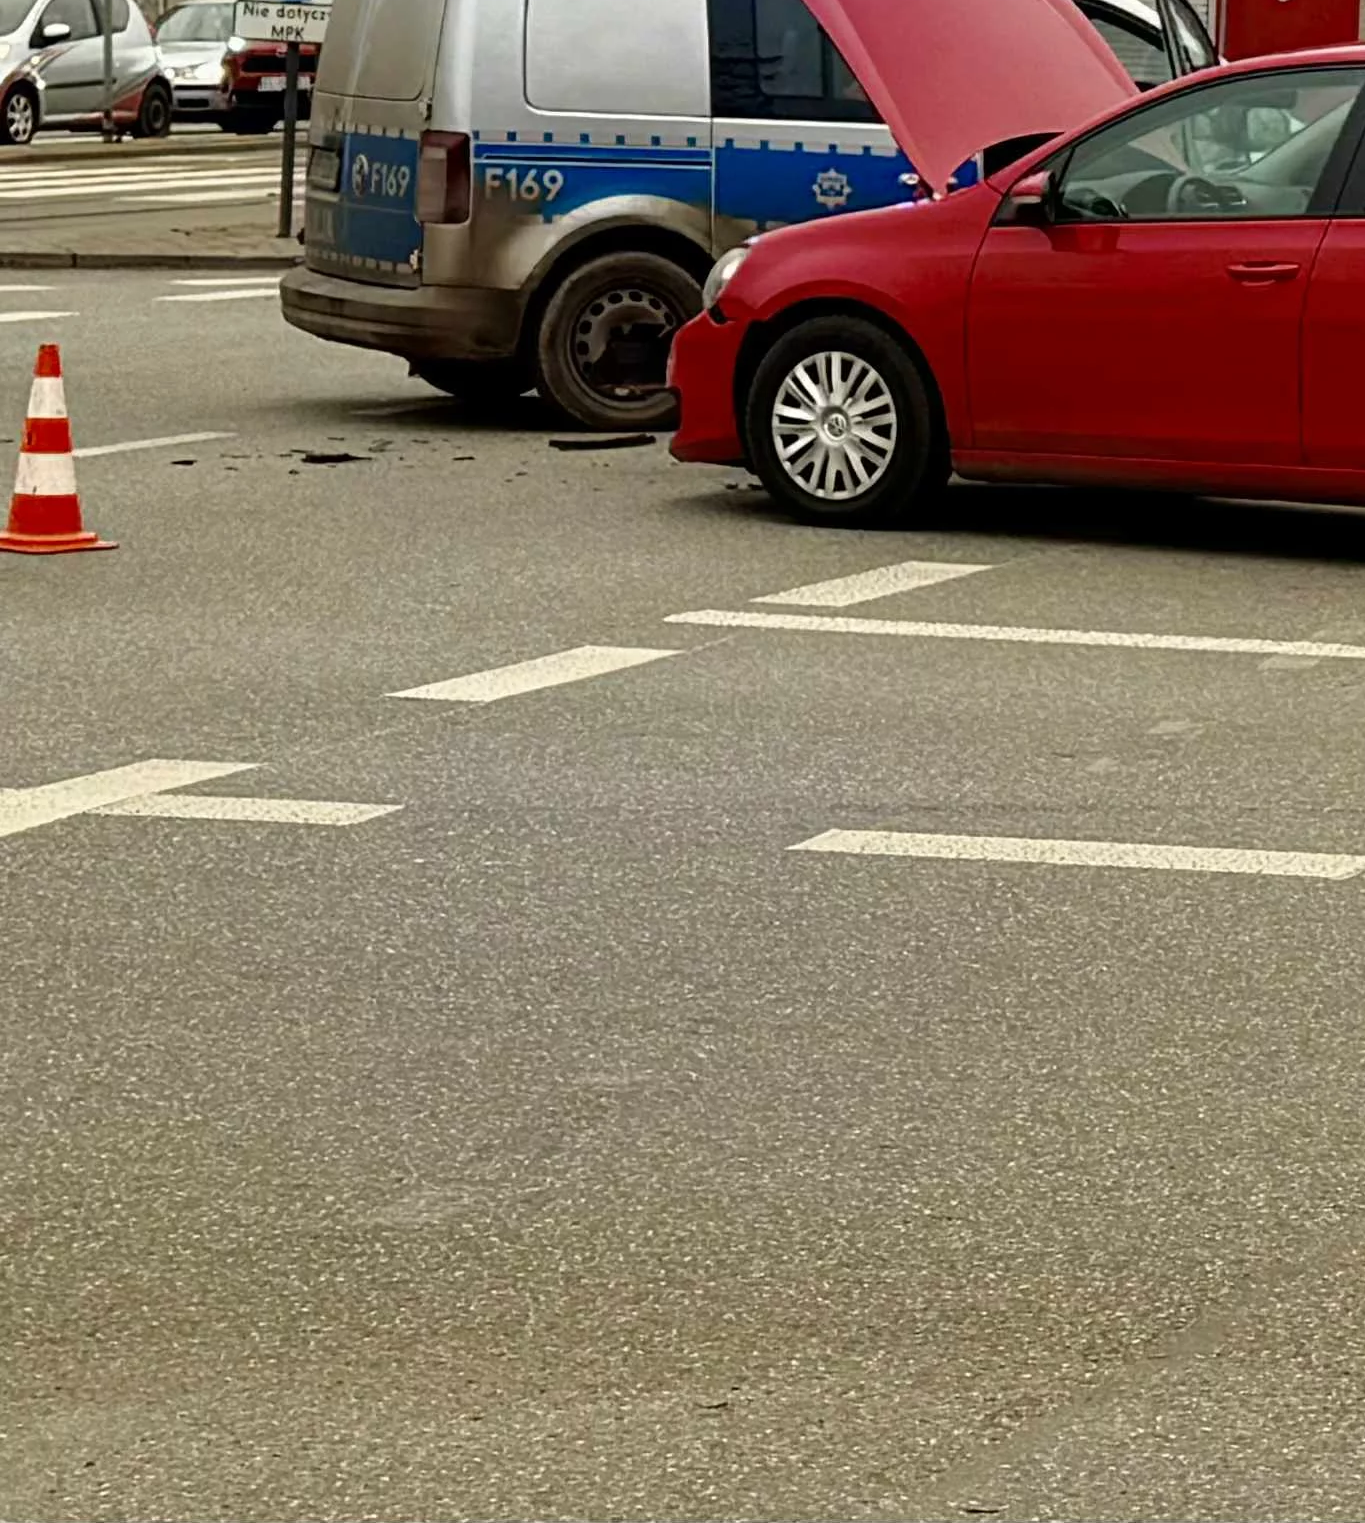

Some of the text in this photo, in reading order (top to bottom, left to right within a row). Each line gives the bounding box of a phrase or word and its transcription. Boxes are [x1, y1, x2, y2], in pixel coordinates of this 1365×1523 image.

[242, 2, 269, 17] Nie
[271, 25, 305, 41] MPK
[371, 161, 410, 198] F169
[484, 167, 565, 202] F169
